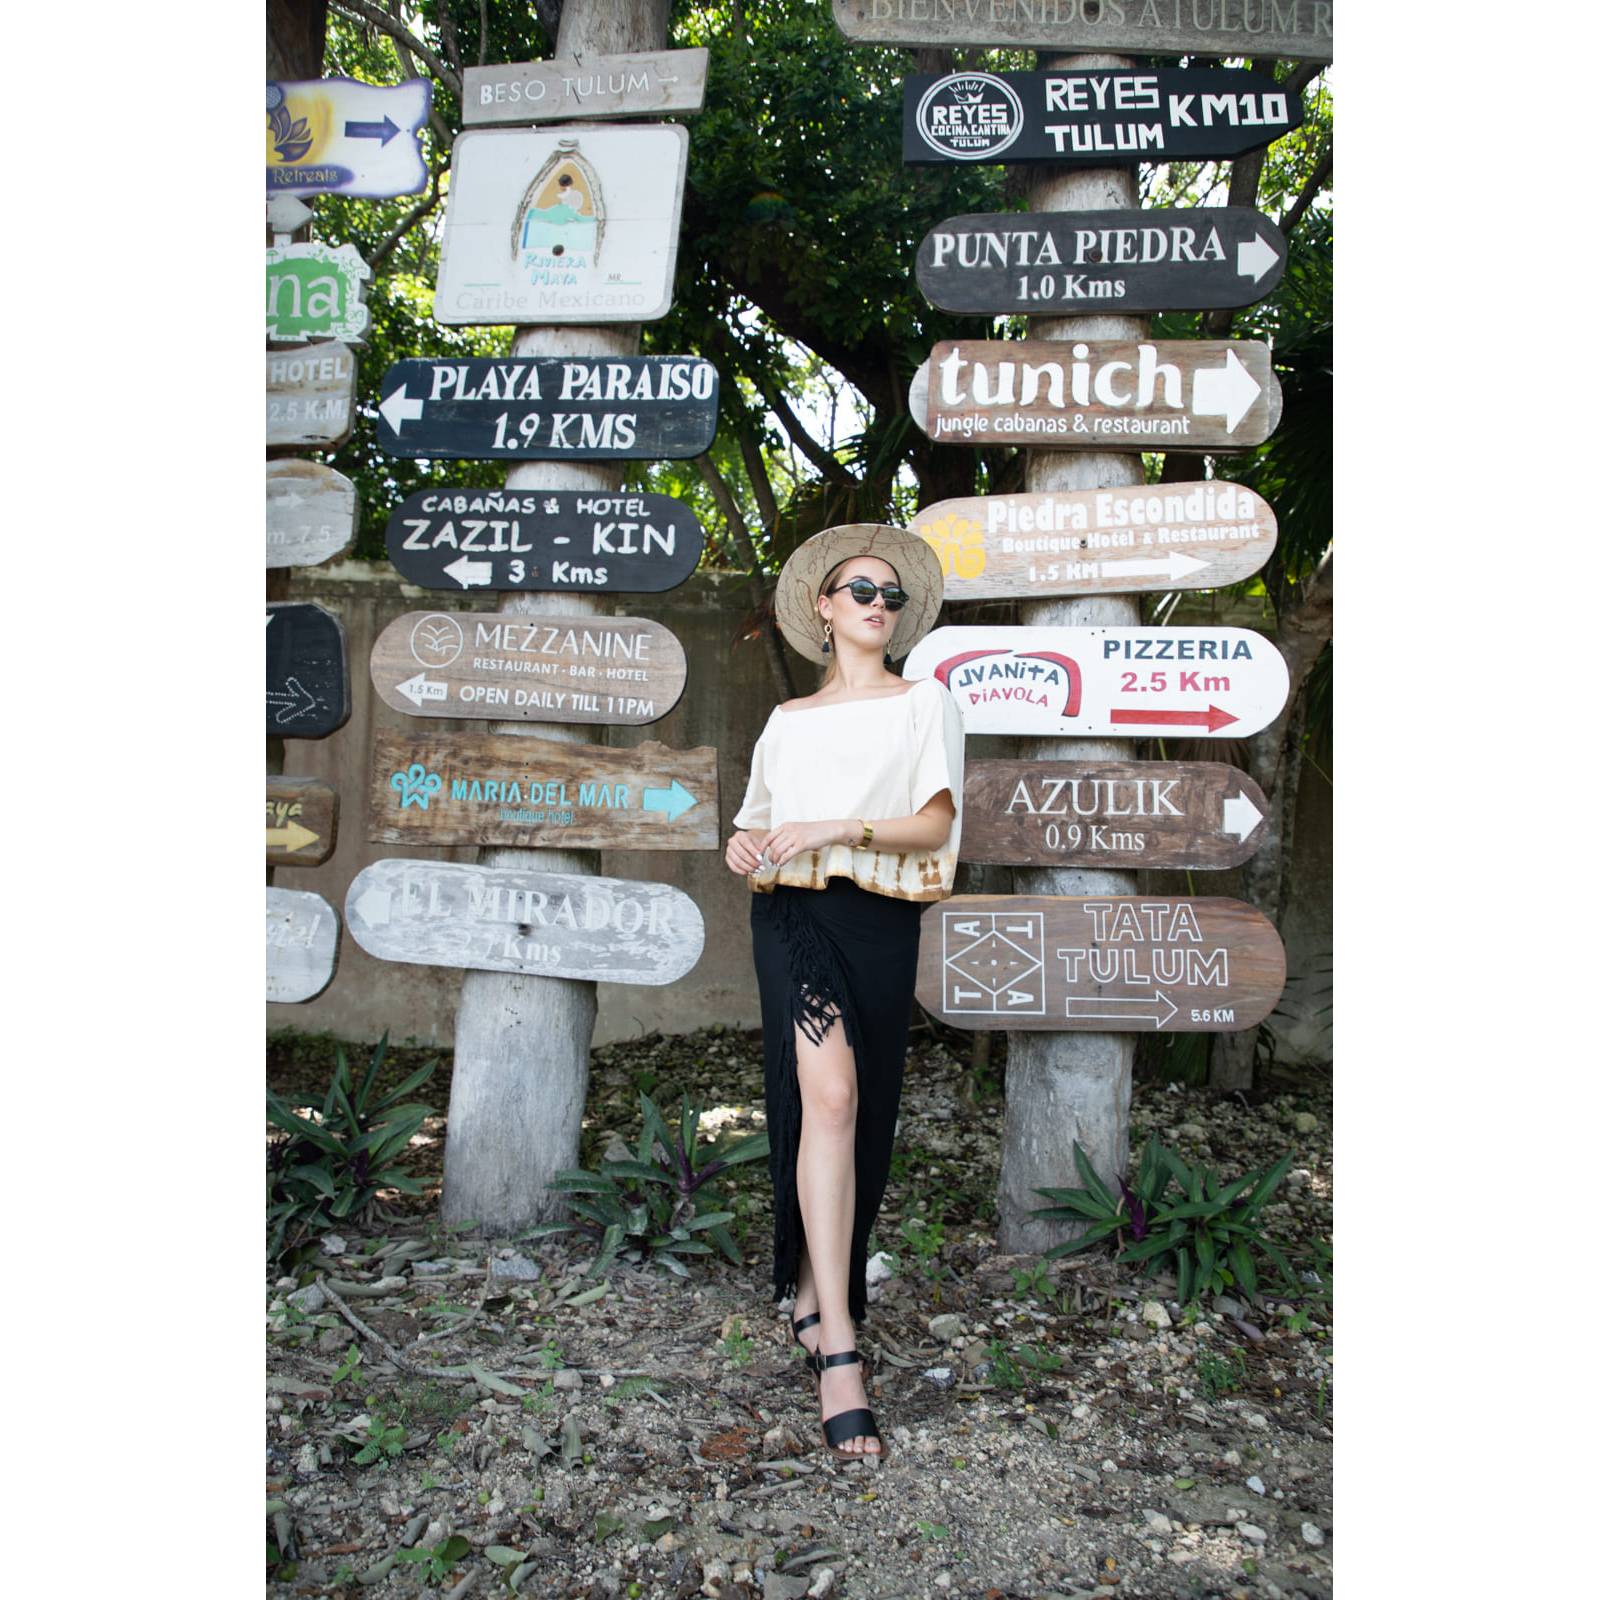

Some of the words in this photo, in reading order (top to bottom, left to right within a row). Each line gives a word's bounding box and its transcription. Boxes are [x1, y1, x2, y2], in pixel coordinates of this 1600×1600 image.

[1137, 0, 1162, 28] A
[480, 79, 546, 105] BESO
[562, 71, 649, 97] TULUM
[1045, 76, 1160, 112] REYES
[932, 104, 1007, 125] REYES
[931, 124, 970, 136] COCINA
[950, 138, 990, 147] TULUM
[1045, 123, 1164, 152] TULUM
[273, 167, 338, 184] Retreats
[929, 231, 1062, 268] PUNTA
[1073, 225, 1226, 265] PIEDRA
[524, 254, 587, 269] RIVIERA
[530, 271, 578, 287] MAYA
[1017, 275, 1055, 300] 1.0
[1062, 274, 1126, 299] Kms
[456, 290, 527, 311] Caribe
[538, 290, 645, 310] Mexicano
[271, 357, 348, 384] HOTEL
[429, 366, 542, 400] PLAYA
[558, 363, 713, 400] PARAISO
[939, 343, 1184, 408] tunich
[270, 401, 298, 421] 2.5
[492, 412, 540, 449] 1.9
[550, 413, 636, 449] KMS
[934, 412, 988, 438] jungle
[994, 412, 1066, 433] cabanas
[1073, 414, 1088, 433] &
[1094, 413, 1191, 435] restaurant
[422, 491, 536, 514] CABAÑAS
[576, 498, 651, 517] HOTEL
[987, 497, 1089, 534] Piedra
[1096, 486, 1256, 529] Escondida
[402, 519, 533, 553] ZAZIL
[592, 521, 675, 556] KIN
[1002, 535, 1081, 555] Boutique
[1087, 530, 1135, 549] Hotel
[1158, 523, 1260, 545] Restaurant
[508, 560, 526, 584] 3
[552, 561, 608, 585] Kms
[1029, 565, 1060, 582] 1.5
[1066, 560, 1099, 580] KM
[475, 622, 653, 661] MEZZANINE
[1103, 640, 1253, 659] PIZZERIA
[473, 657, 560, 675] RESTAURANT
[569, 664, 595, 678] BAR
[606, 667, 649, 682] HOTEL
[1121, 672, 1167, 692] 2.5
[1179, 672, 1231, 692] Km
[460, 685, 509, 705] OPEN
[515, 689, 566, 710] DAILY
[571, 693, 600, 712] TILL
[607, 697, 655, 717] 11PM
[451, 779, 521, 803] MARIA
[530, 781, 573, 807] DEL
[579, 783, 628, 808] MAR
[1005, 779, 1185, 816] AZULIK
[1046, 825, 1082, 850] 0.9
[1091, 825, 1145, 850] Kms
[402, 876, 451, 917] EL
[465, 883, 673, 936] MIRADOR
[1084, 903, 1203, 942] TATA
[503, 935, 562, 965] Kms
[1057, 948, 1229, 987] TULUM
[1191, 1007, 1211, 1023] 5.6
[1213, 1007, 1234, 1023] KM
